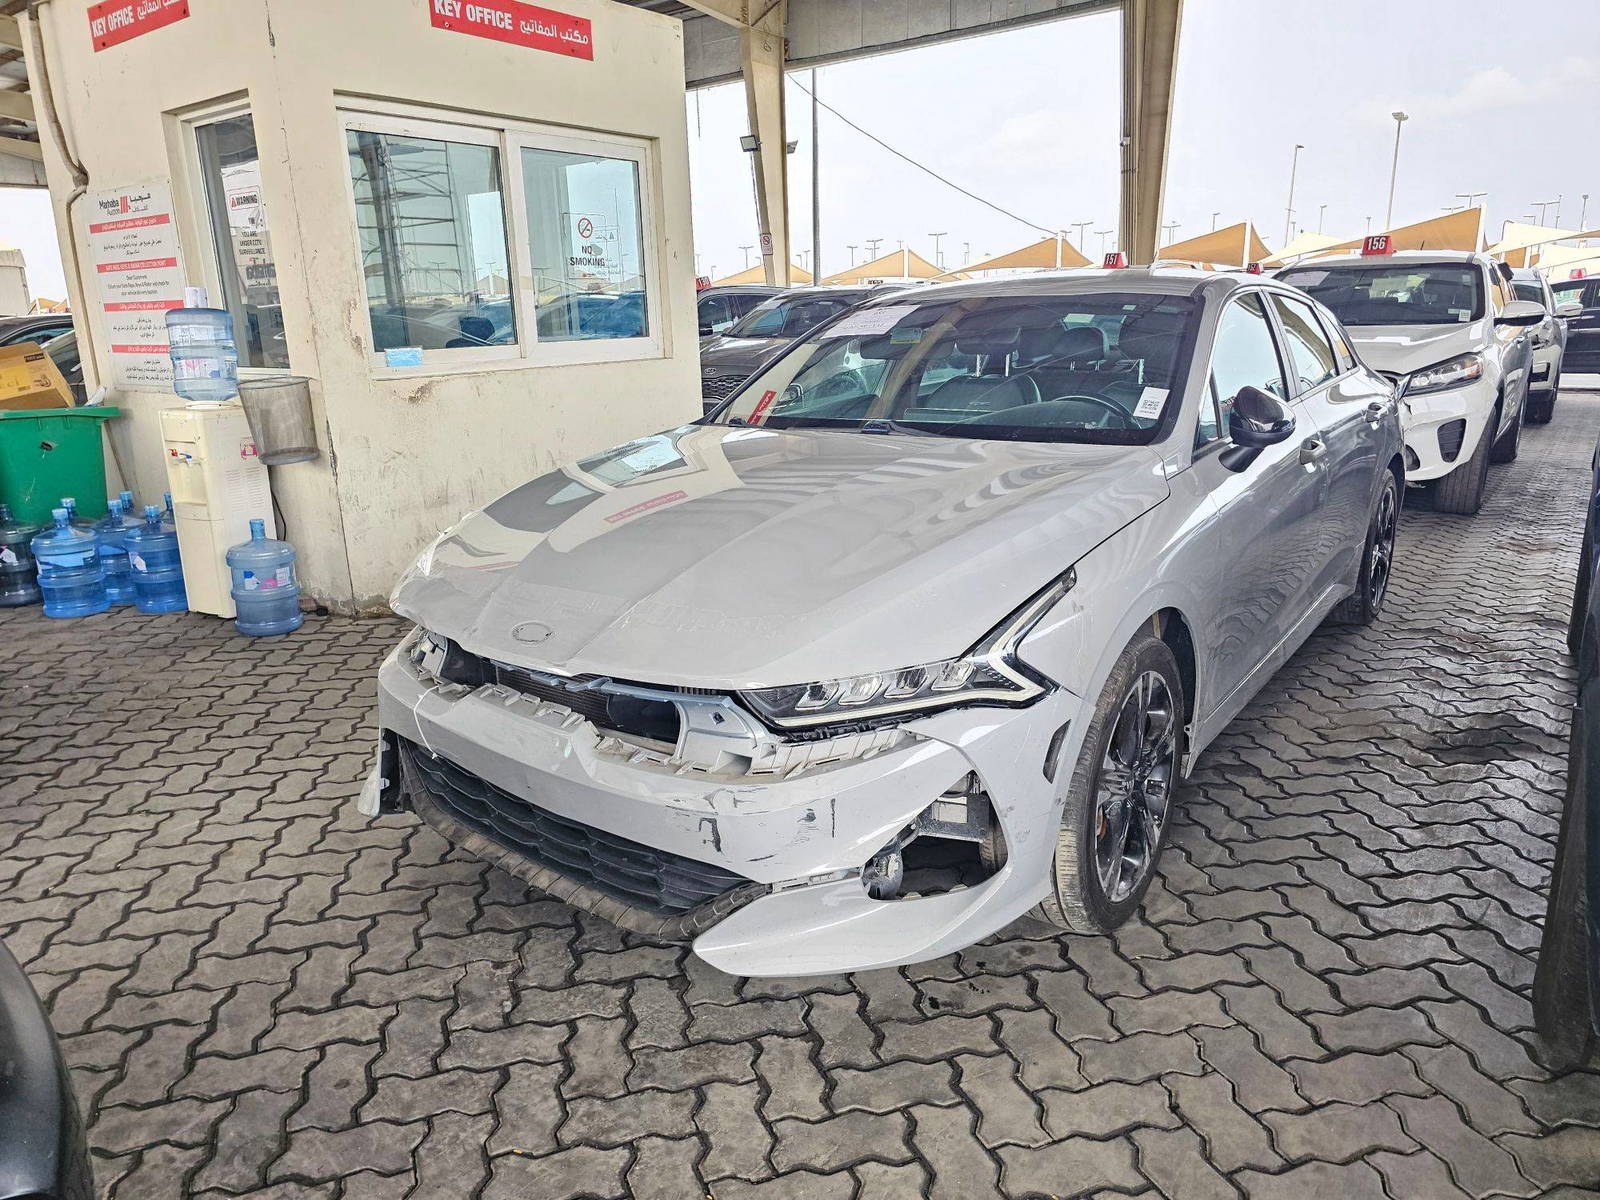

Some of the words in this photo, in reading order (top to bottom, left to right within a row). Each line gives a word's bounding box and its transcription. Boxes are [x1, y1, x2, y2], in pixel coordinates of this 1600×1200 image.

[91, 17, 108, 38] KEY
[107, 5, 135, 32] OFFICE
[434, 0, 462, 19] KEY
[465, 3, 514, 31] OFFICE
[519, 19, 558, 38] المفاتيح
[559, 28, 589, 45] مكتب
[236, 194, 258, 206] WARNING
[581, 244, 593, 255] NO
[1367, 236, 1387, 250] 156
[569, 256, 606, 267] SMOKING
[1105, 254, 1118, 265] 151
